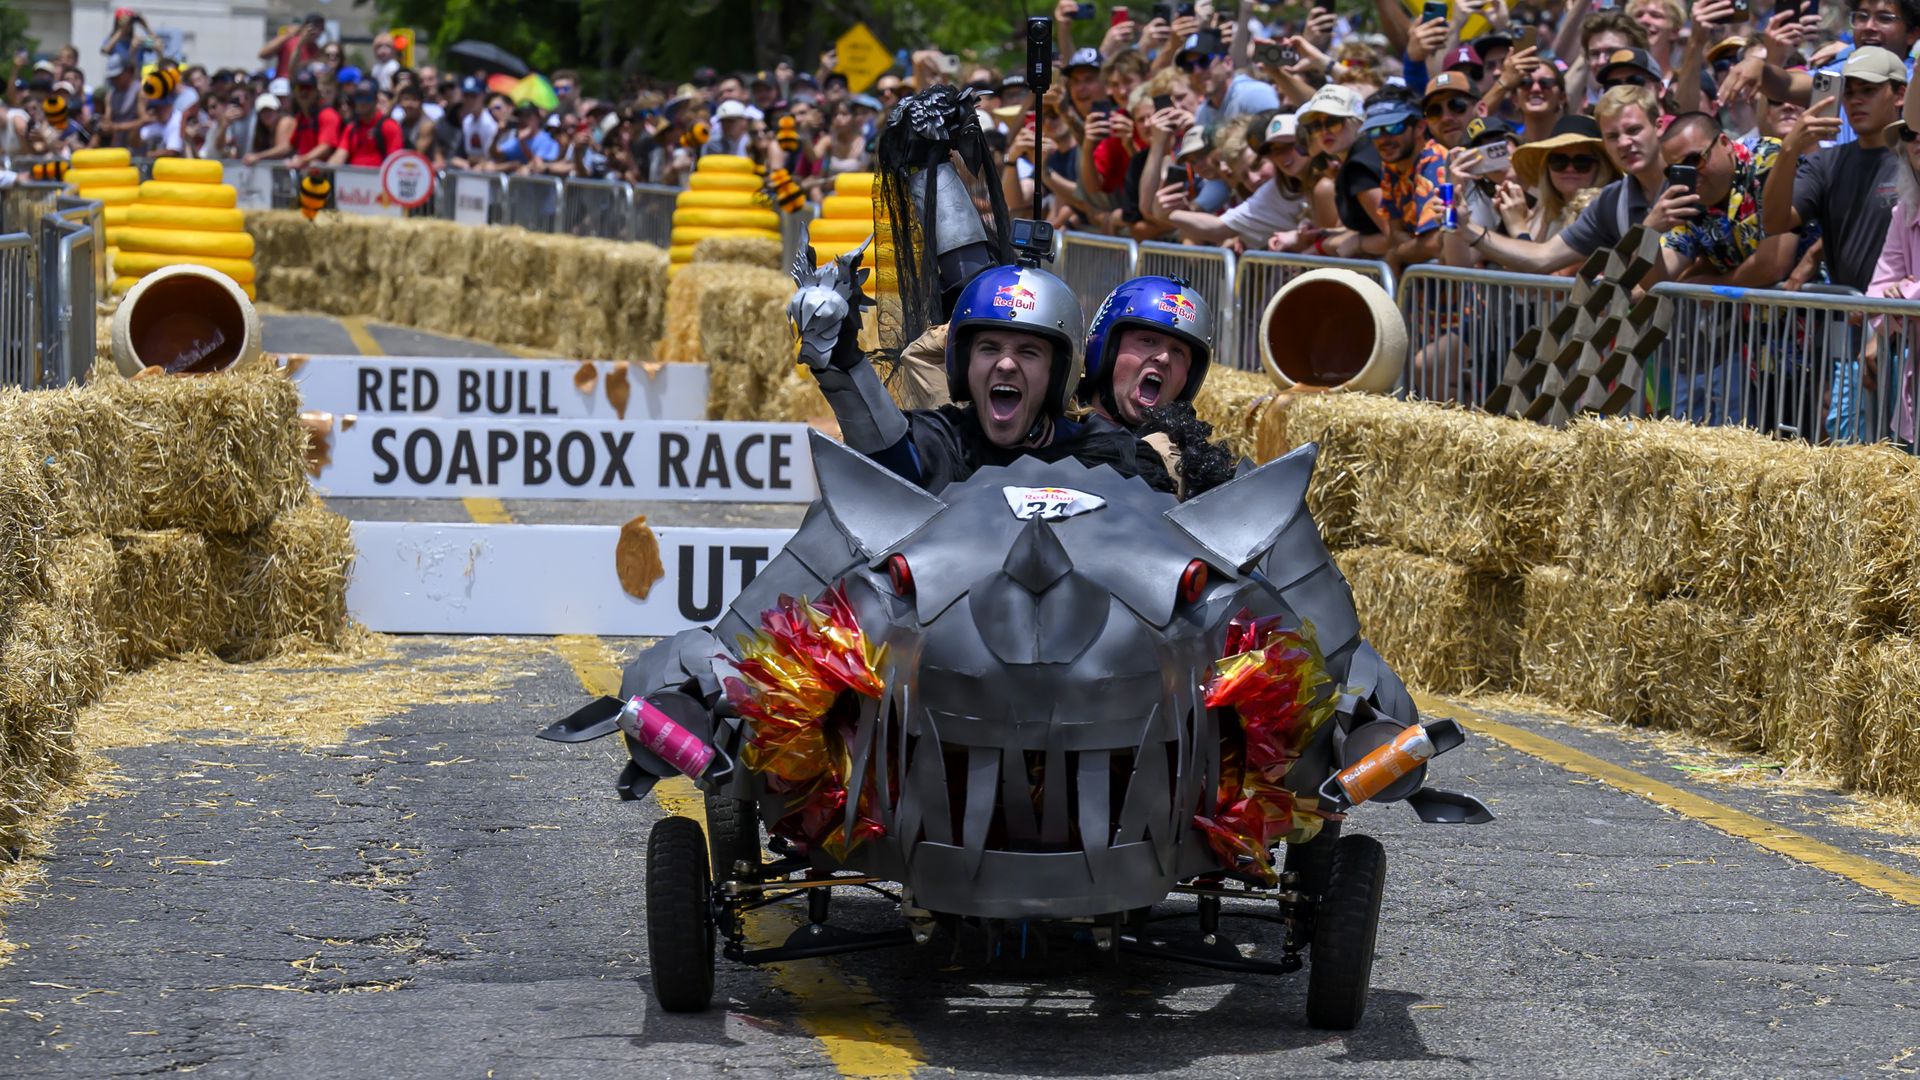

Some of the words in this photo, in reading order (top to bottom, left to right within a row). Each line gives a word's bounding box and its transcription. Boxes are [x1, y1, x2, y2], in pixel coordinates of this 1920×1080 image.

[993, 296, 1014, 307] Red
[1015, 299, 1036, 311] Bull
[1159, 301, 1178, 313] Red
[1178, 307, 1196, 322] Bull
[358, 367, 438, 412] RED
[459, 369, 558, 414] BULL
[371, 427, 635, 487] SOAPBOX
[658, 432, 792, 490] RACE
